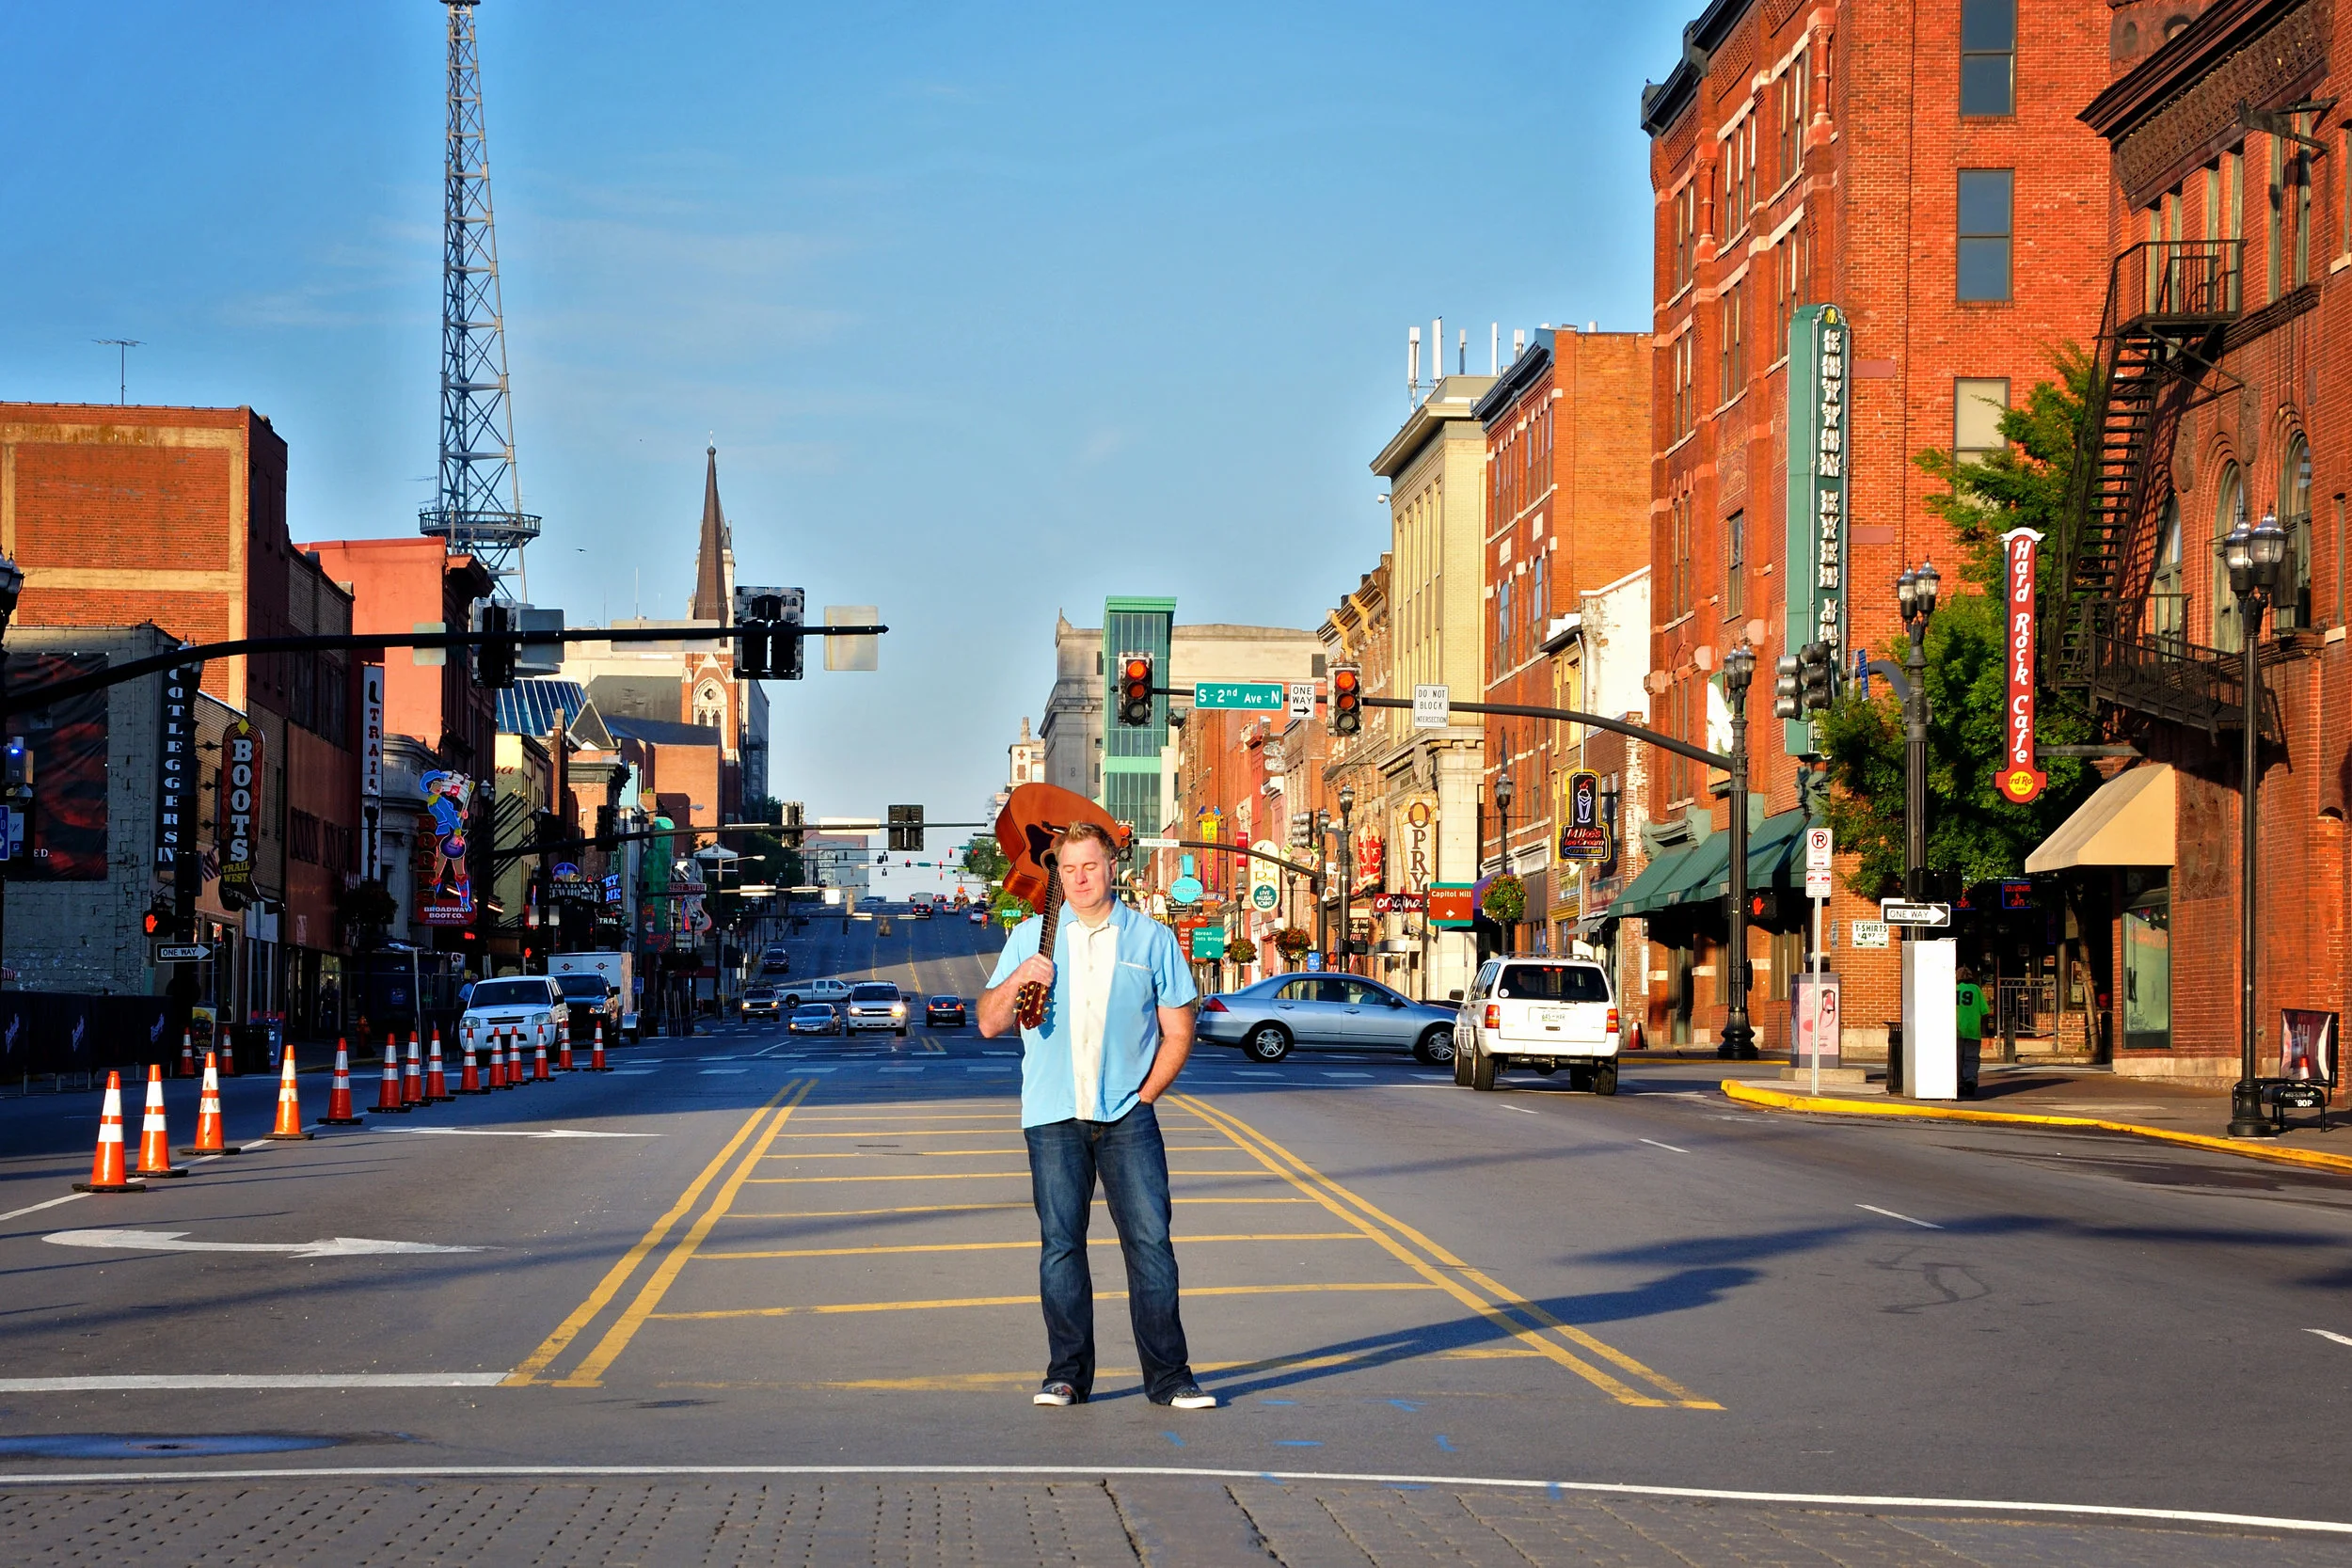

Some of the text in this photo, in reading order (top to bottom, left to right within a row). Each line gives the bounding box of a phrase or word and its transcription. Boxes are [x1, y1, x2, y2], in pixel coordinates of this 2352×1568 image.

[2012, 540, 2031, 764] Hard Rock Cafe
[1293, 687, 1312, 696] ONE
[1418, 689, 1446, 699] DO NOT
[1292, 697, 1312, 705] WAY
[1420, 701, 1443, 710] BLOCK
[230, 739, 252, 862] BOOTS
[1577, 837, 1605, 847] Cream
[1407, 801, 1430, 893] OPRY
[222, 861, 250, 873] TRAIL
[224, 872, 247, 883] WEST
[1431, 891, 1457, 899] Capitol
[1889, 910, 1929, 919] ONE WAY
[1855, 924, 1887, 933] T-SHIRTS
[163, 948, 197, 957] ONE WAY
